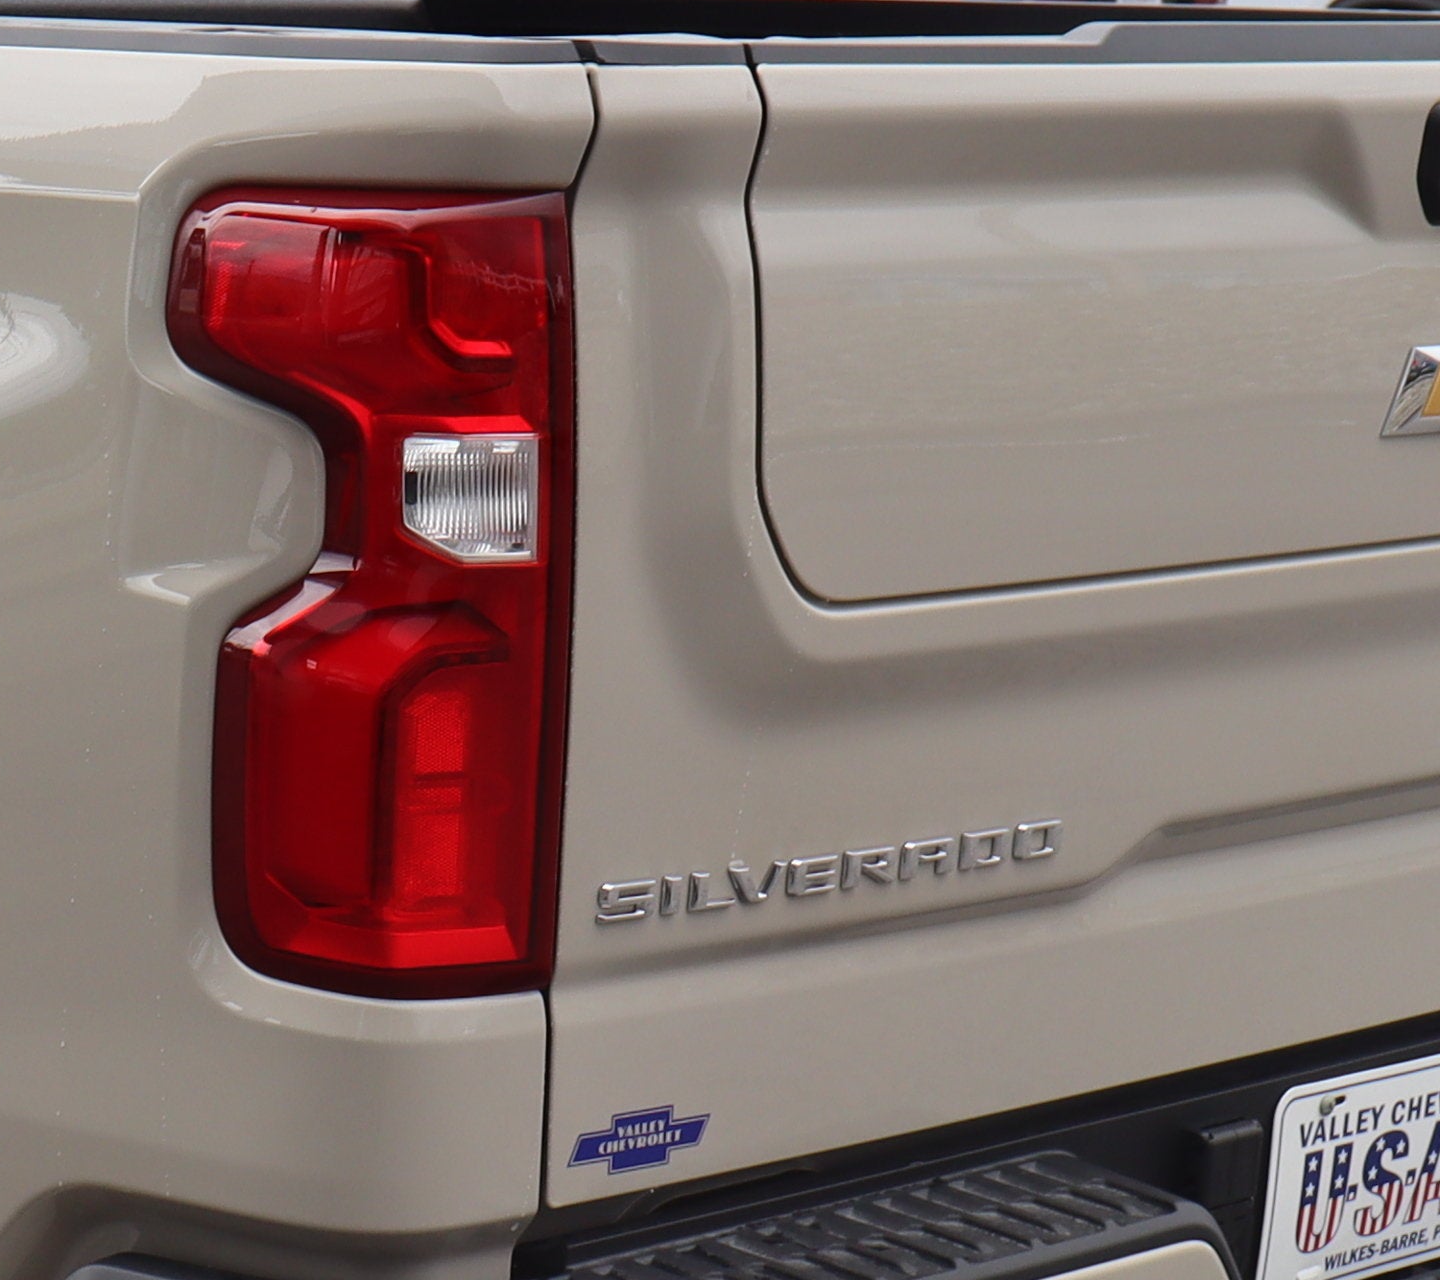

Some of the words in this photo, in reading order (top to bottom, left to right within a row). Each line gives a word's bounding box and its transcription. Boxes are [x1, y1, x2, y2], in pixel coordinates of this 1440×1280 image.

[595, 819, 1062, 923] SILVERADO
[598, 1128, 682, 1155] CHEVROLET
[617, 1119, 668, 1138] VALLEY
[1298, 1102, 1387, 1149] VALLEY
[1323, 1232, 1429, 1273] WILKES-BARRE,
